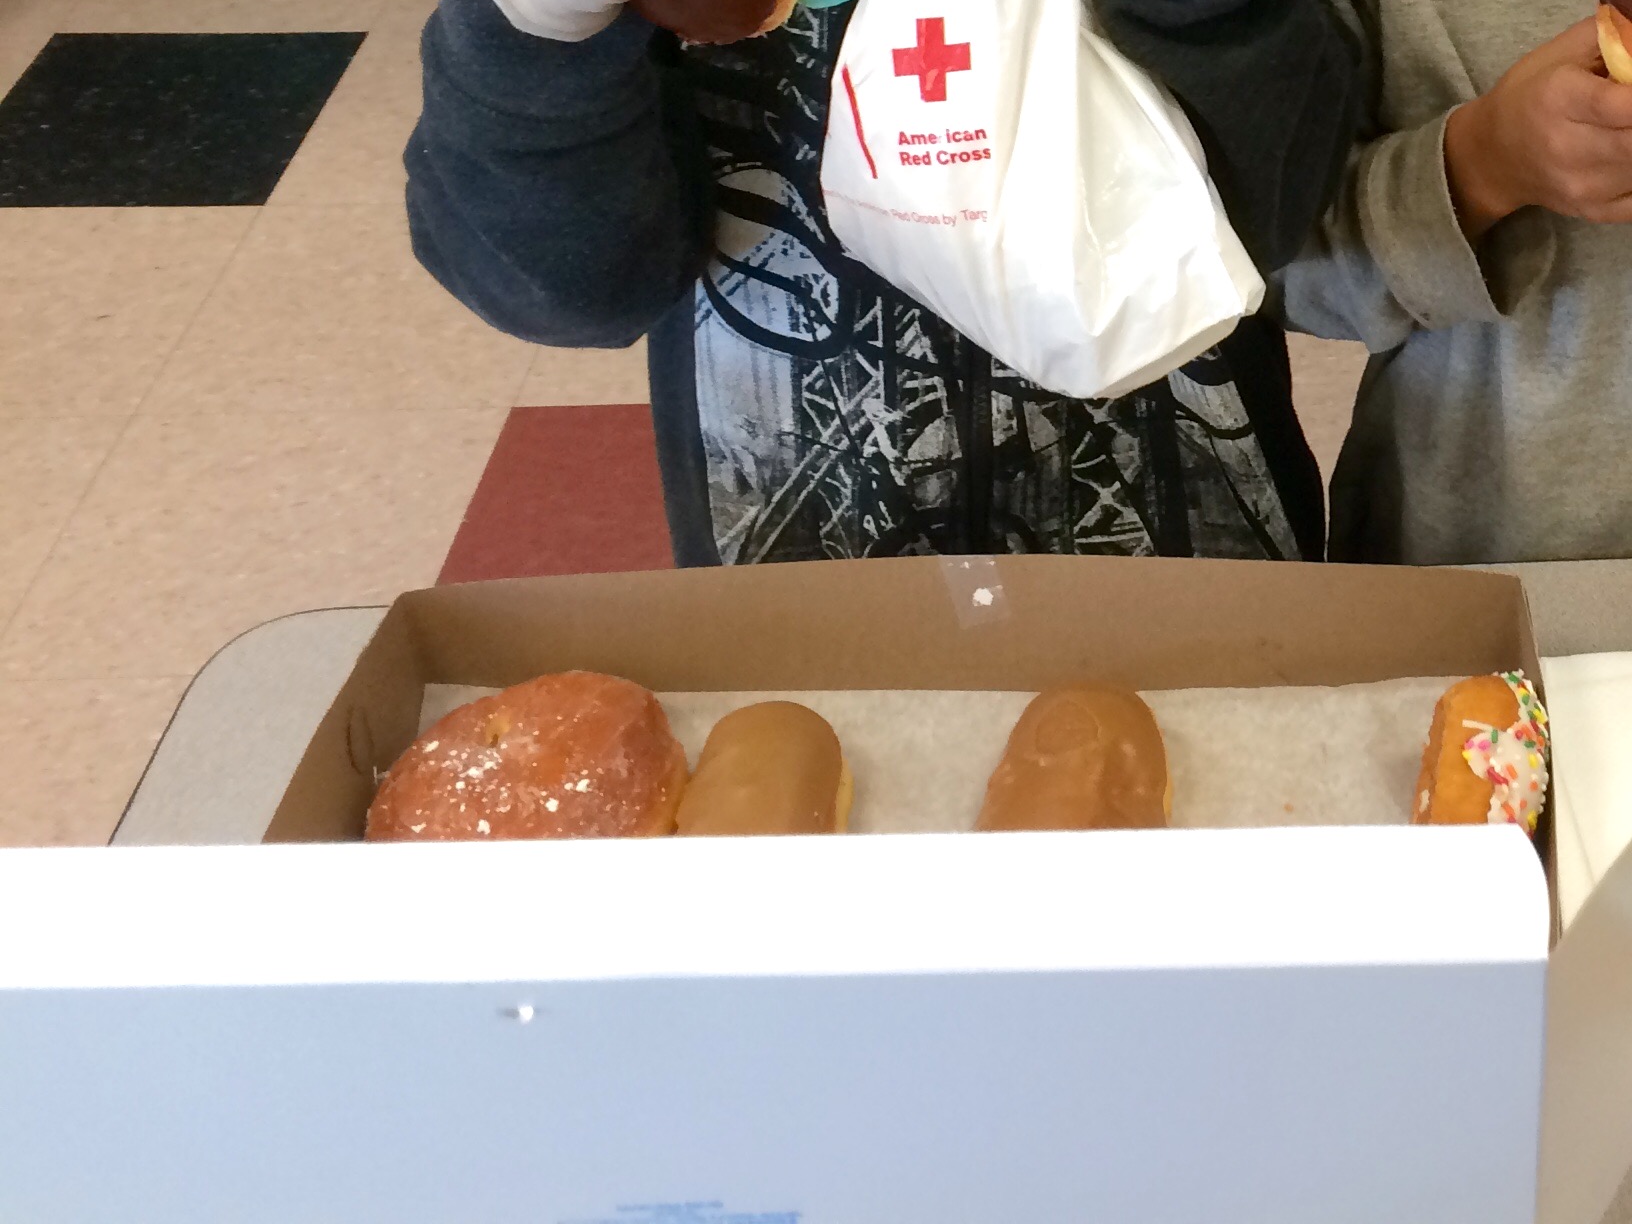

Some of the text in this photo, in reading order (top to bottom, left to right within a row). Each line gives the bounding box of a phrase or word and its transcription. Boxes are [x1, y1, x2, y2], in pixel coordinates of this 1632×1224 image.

[898, 128, 987, 146] Ameican
[899, 147, 991, 166] Red Cross
[942, 213, 957, 227] by
